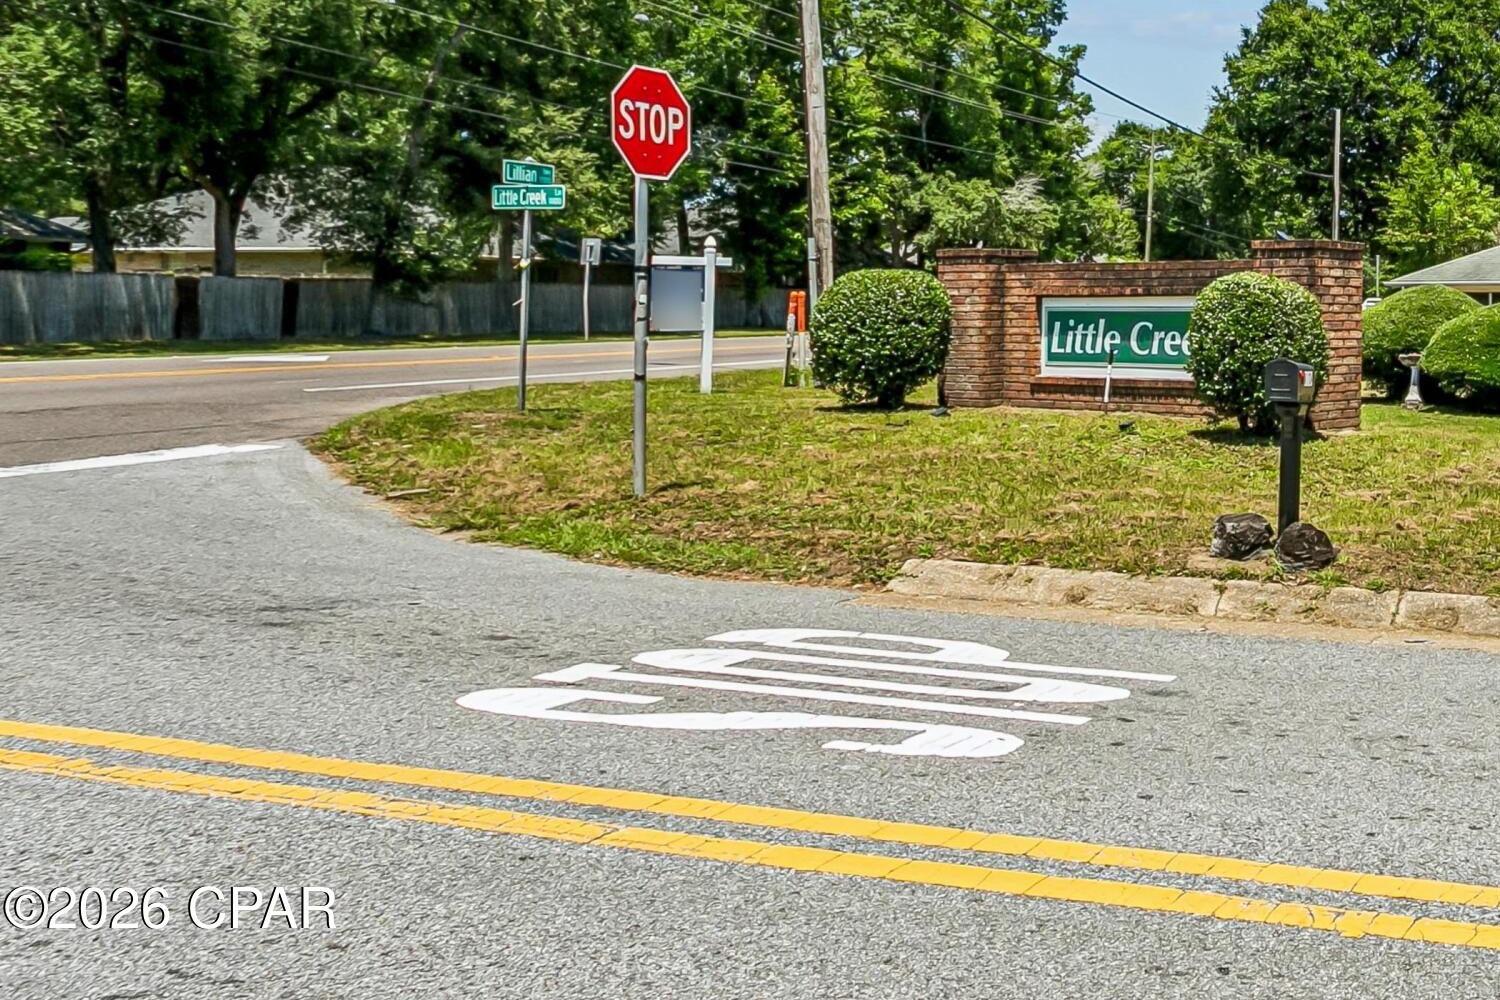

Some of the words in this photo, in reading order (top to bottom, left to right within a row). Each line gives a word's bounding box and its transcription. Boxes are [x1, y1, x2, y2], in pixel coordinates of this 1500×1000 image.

[618, 98, 684, 145] STOP
[506, 163, 537, 182] Lillian
[494, 188, 518, 206] Little
[519, 188, 547, 206] Creek
[1050, 318, 1121, 355] Little
[1130, 321, 1192, 356] Cree
[455, 627, 1178, 758] STOP
